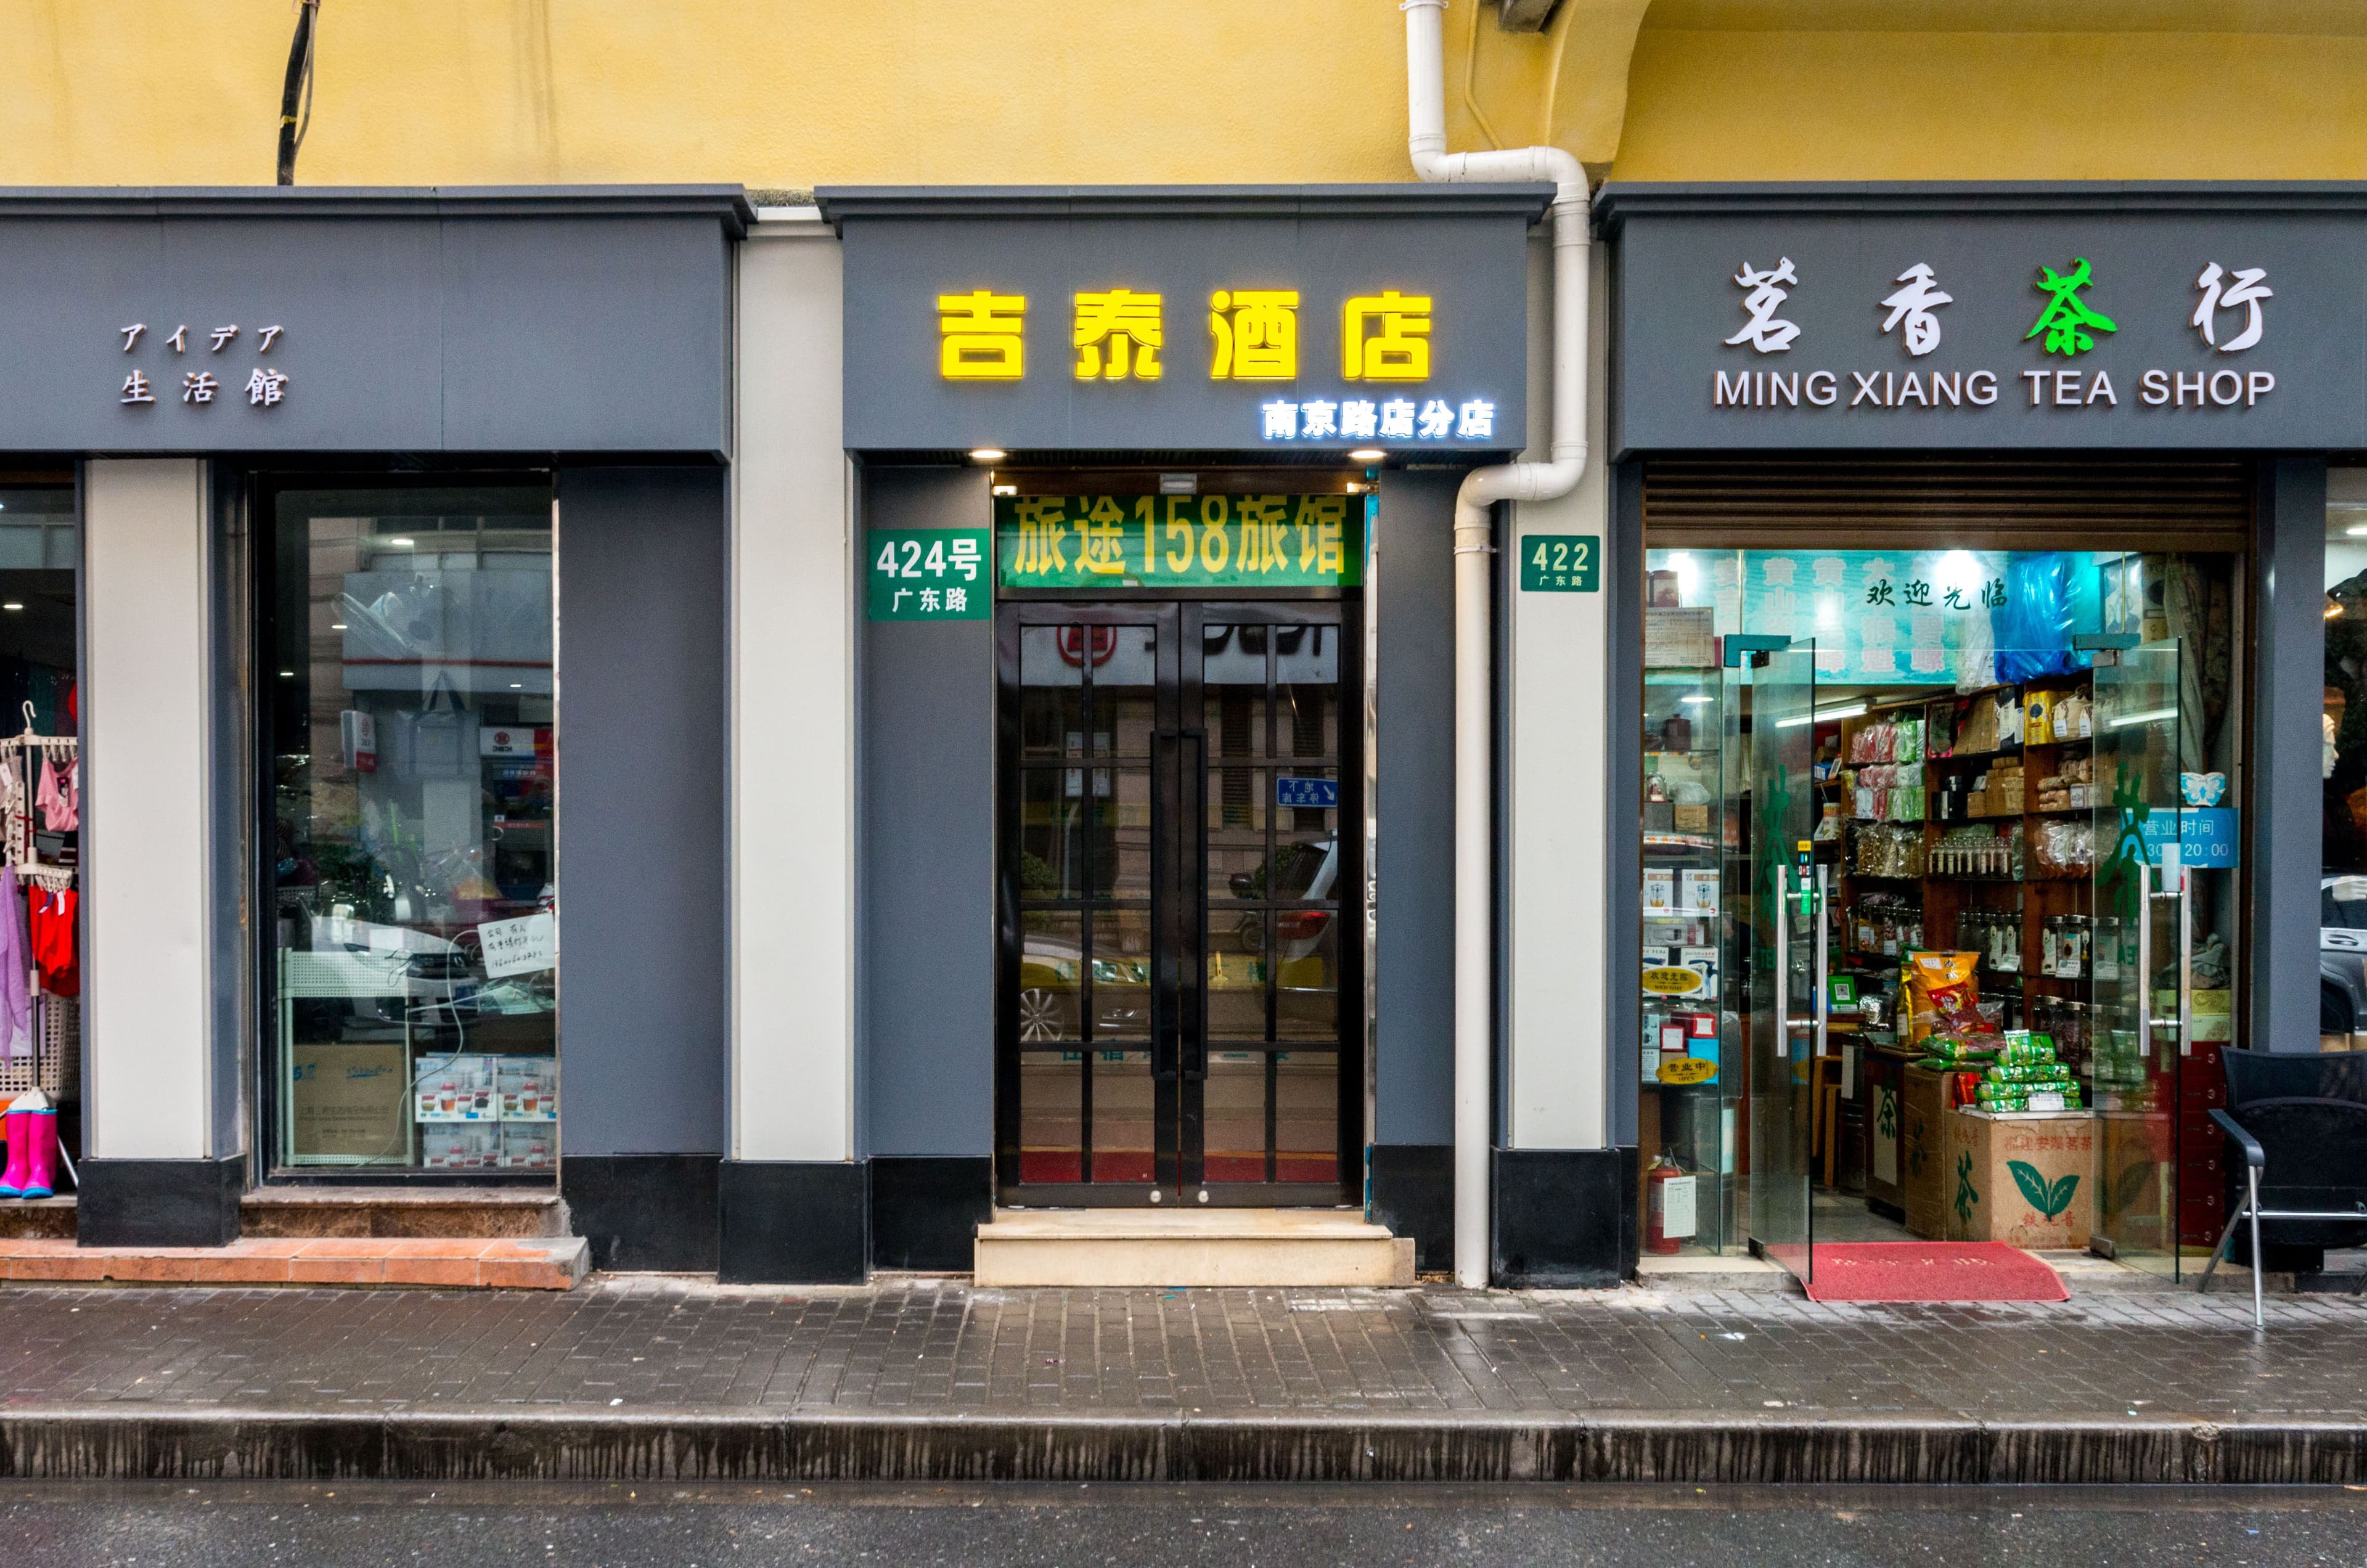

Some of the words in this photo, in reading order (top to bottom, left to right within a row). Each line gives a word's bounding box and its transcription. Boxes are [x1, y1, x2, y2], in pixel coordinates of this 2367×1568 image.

[1723, 256, 2274, 356] 茗香茶行
[121, 324, 284, 354] アイデア
[936, 288, 1433, 381] 吉泰酒店
[121, 368, 288, 406] 生活館
[1714, 370, 1836, 408] MING
[1850, 370, 1998, 408] XIANG
[2021, 370, 2117, 407] TEA
[2138, 369, 2276, 407] SHOP
[1014, 494, 1347, 576] 旅途158旅馆
[877, 539, 981, 581] 424号
[1532, 542, 1588, 571] 422
[1539, 575, 1582, 586] 广东路
[1867, 578, 2007, 610] 欢迎光临
[893, 587, 967, 613] 广东路
[2143, 819, 2214, 836] 营业时间
[1668, 1062, 1706, 1072] 营业中
